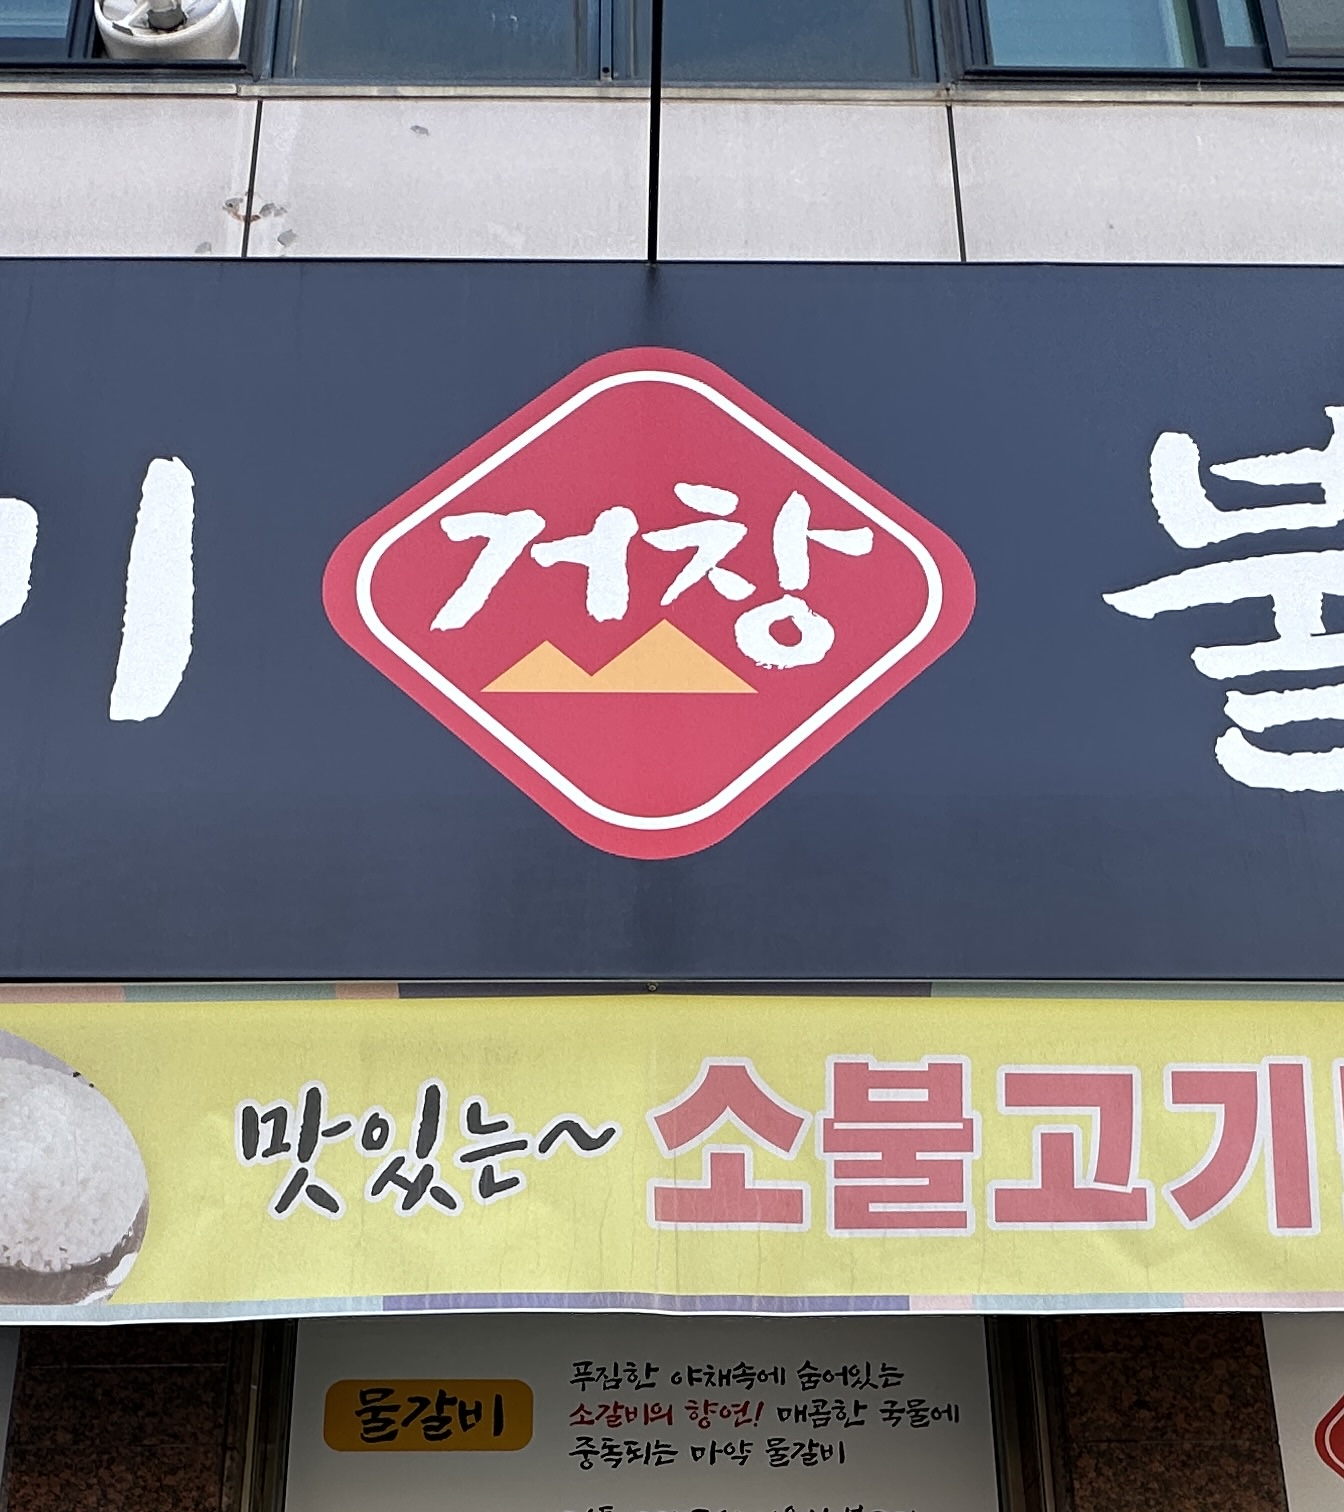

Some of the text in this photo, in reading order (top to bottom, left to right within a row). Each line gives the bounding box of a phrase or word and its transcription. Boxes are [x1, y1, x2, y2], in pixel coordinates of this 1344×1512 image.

[429, 483, 873, 671] 거창
[568, 1360, 904, 1391] 푸짐한 야채속에 숨어있는
[355, 1386, 504, 1444] 물갈비
[568, 1399, 960, 1429] 소갈비의 향연! 매콤한 국물에
[568, 1436, 845, 1470] 중독되는 마약 물갈비
